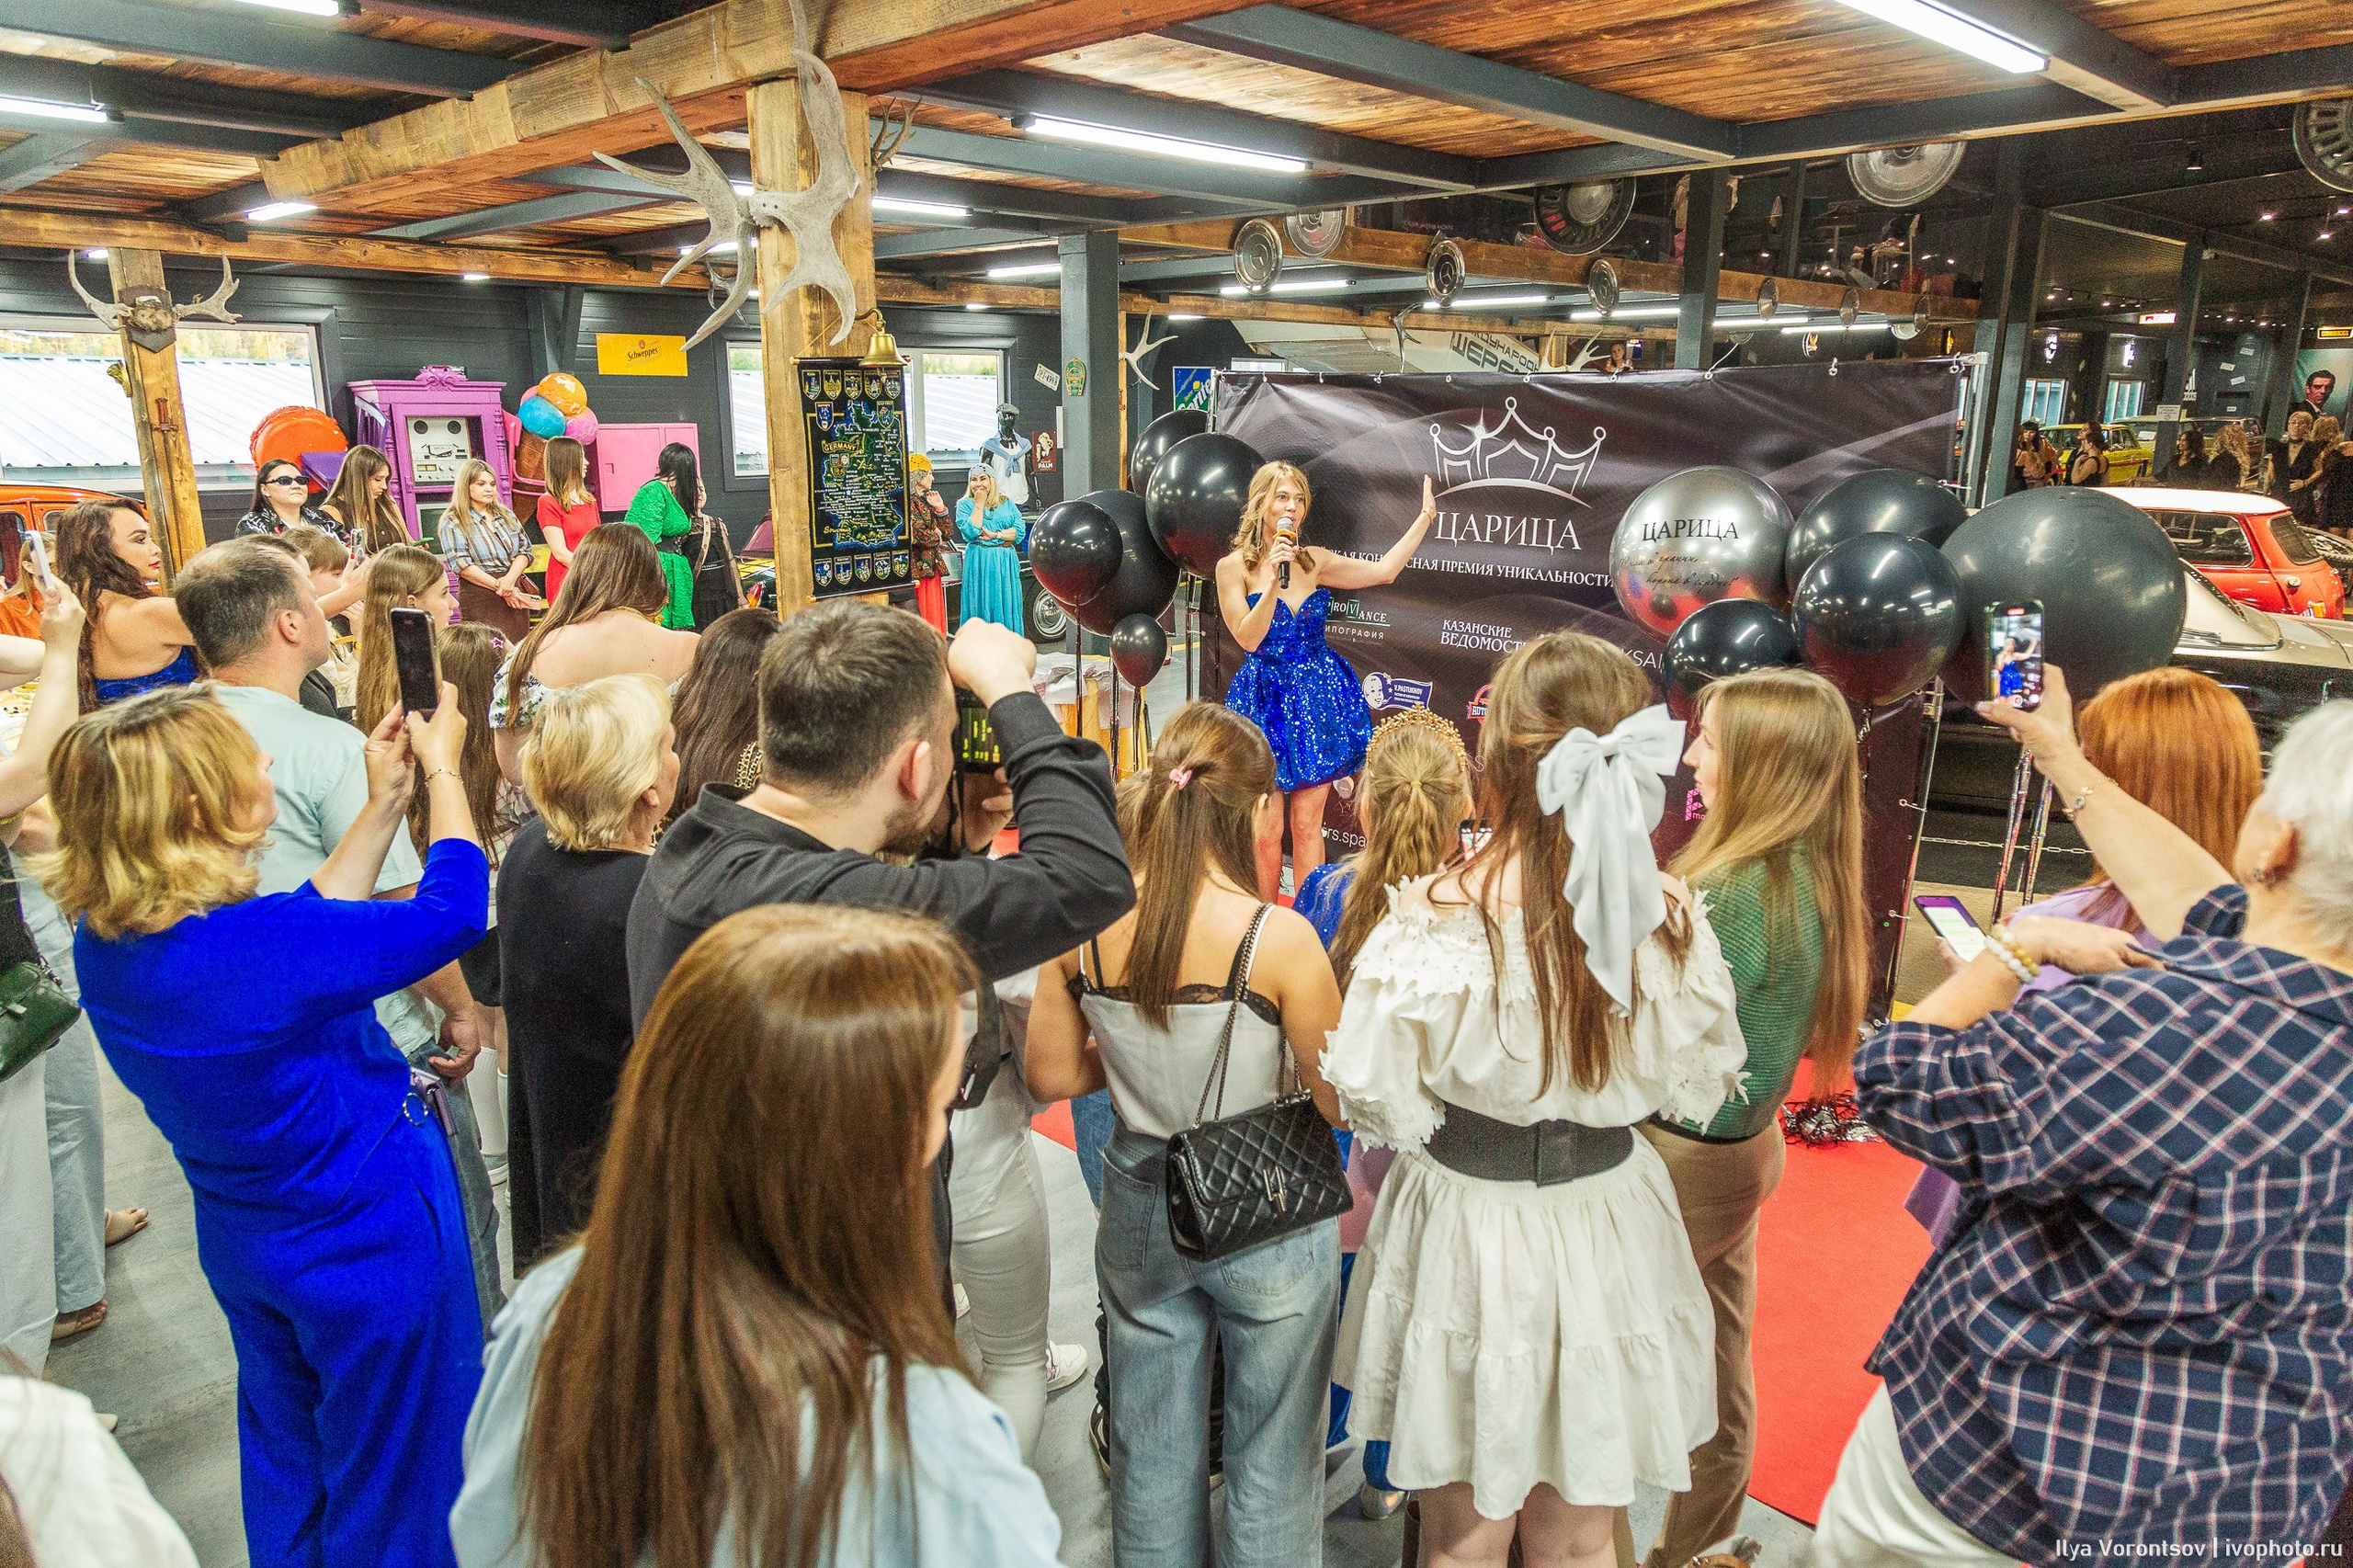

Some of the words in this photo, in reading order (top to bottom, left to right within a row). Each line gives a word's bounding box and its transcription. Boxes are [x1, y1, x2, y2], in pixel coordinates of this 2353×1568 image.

[627, 347, 658, 361] Schweppes
[1450, 332, 1519, 372] ШЕРЕ
[824, 441, 856, 451] GERMANY
[1435, 511, 1582, 556] ЦАРИЦА
[1643, 519, 1739, 543] ЦАРИЦА
[1441, 560, 1494, 576] ПРЕМИЯ
[1497, 565, 1614, 587] УНИКАЛЬНОСТИ
[1324, 625, 1384, 640] ИПОГРАФИЯ
[1443, 619, 1512, 638] КАЗАНСКИЕ
[1440, 631, 1527, 653] ВЕДОМОСТ
